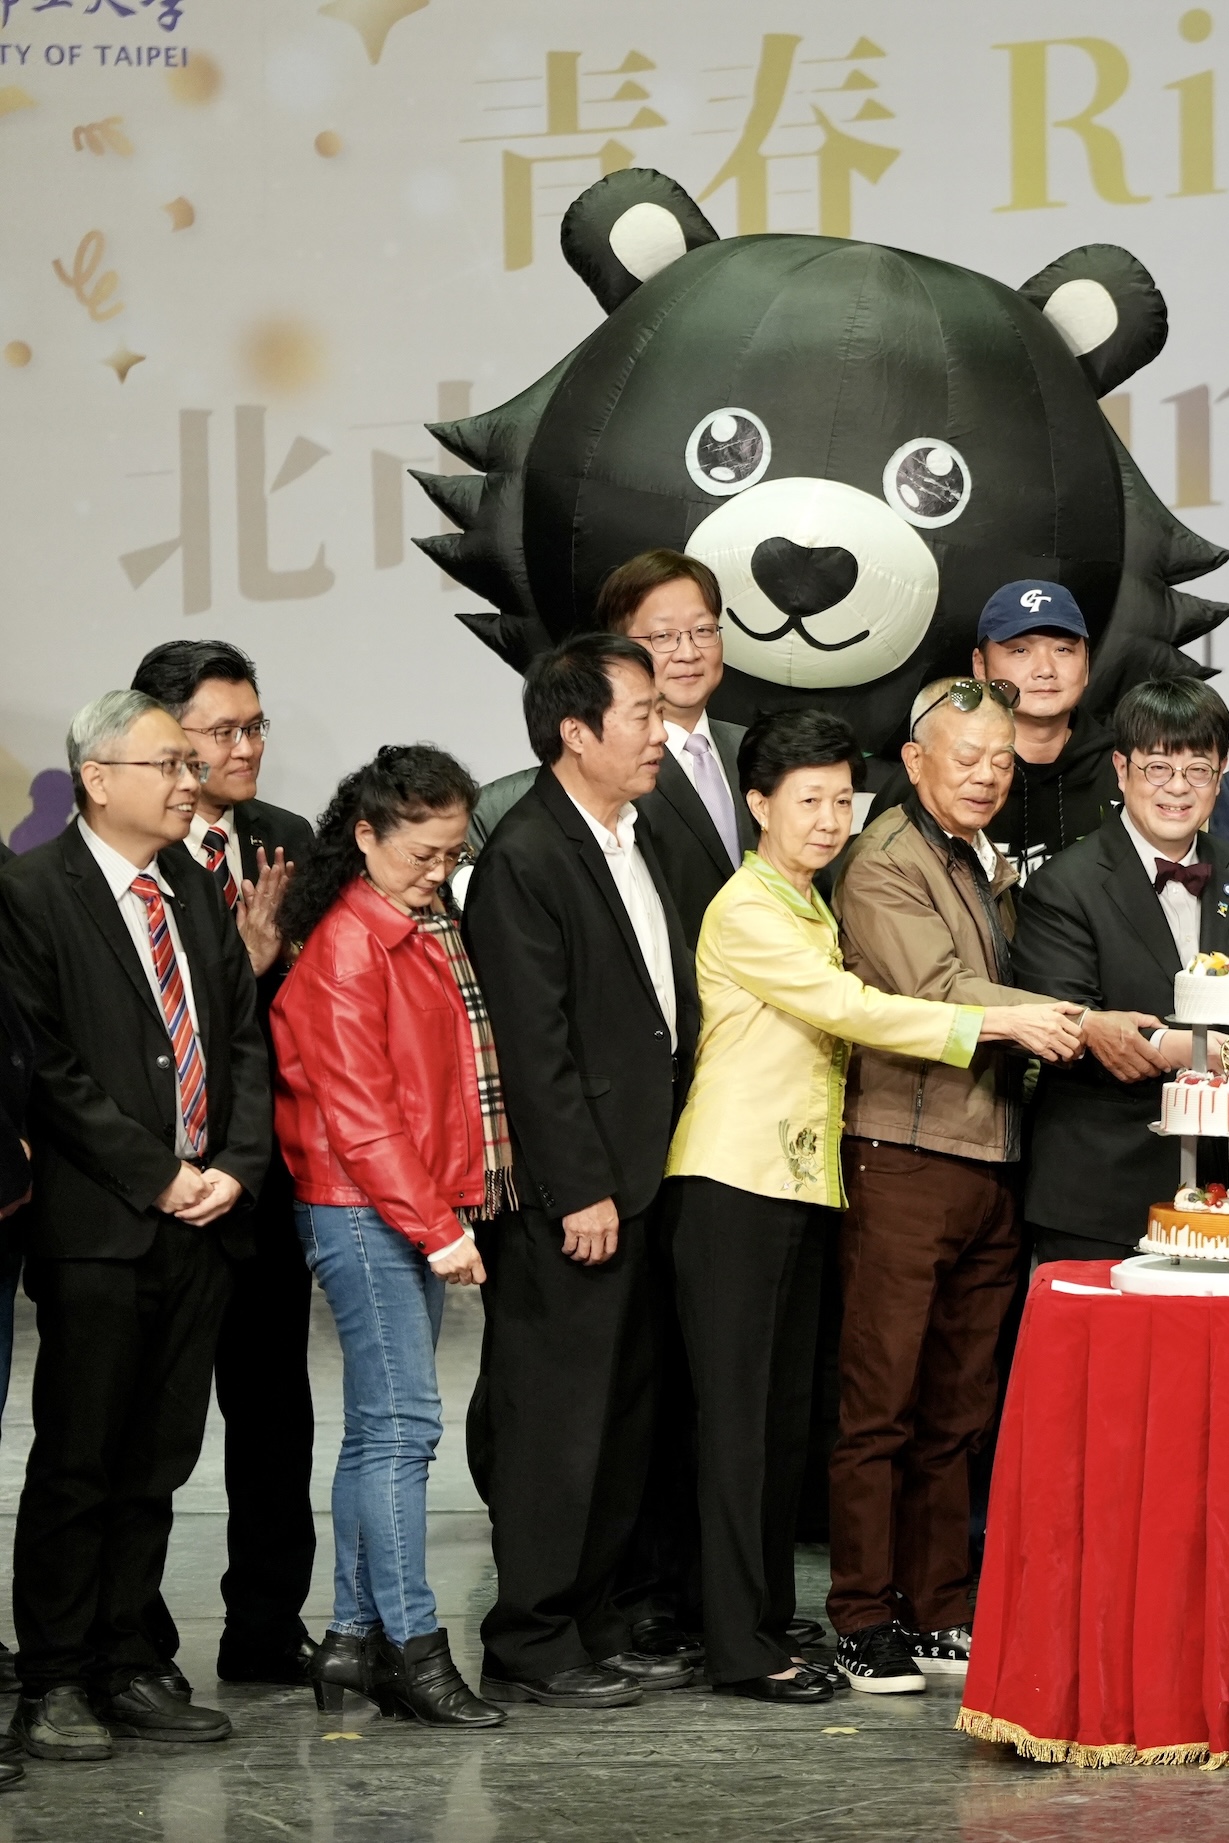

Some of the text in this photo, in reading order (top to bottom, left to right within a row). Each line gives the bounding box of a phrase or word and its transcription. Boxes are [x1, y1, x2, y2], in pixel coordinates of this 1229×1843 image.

[44, 44, 82, 67] OF
[93, 45, 188, 68] TAIPEI
[460, 32, 902, 271] 青春
